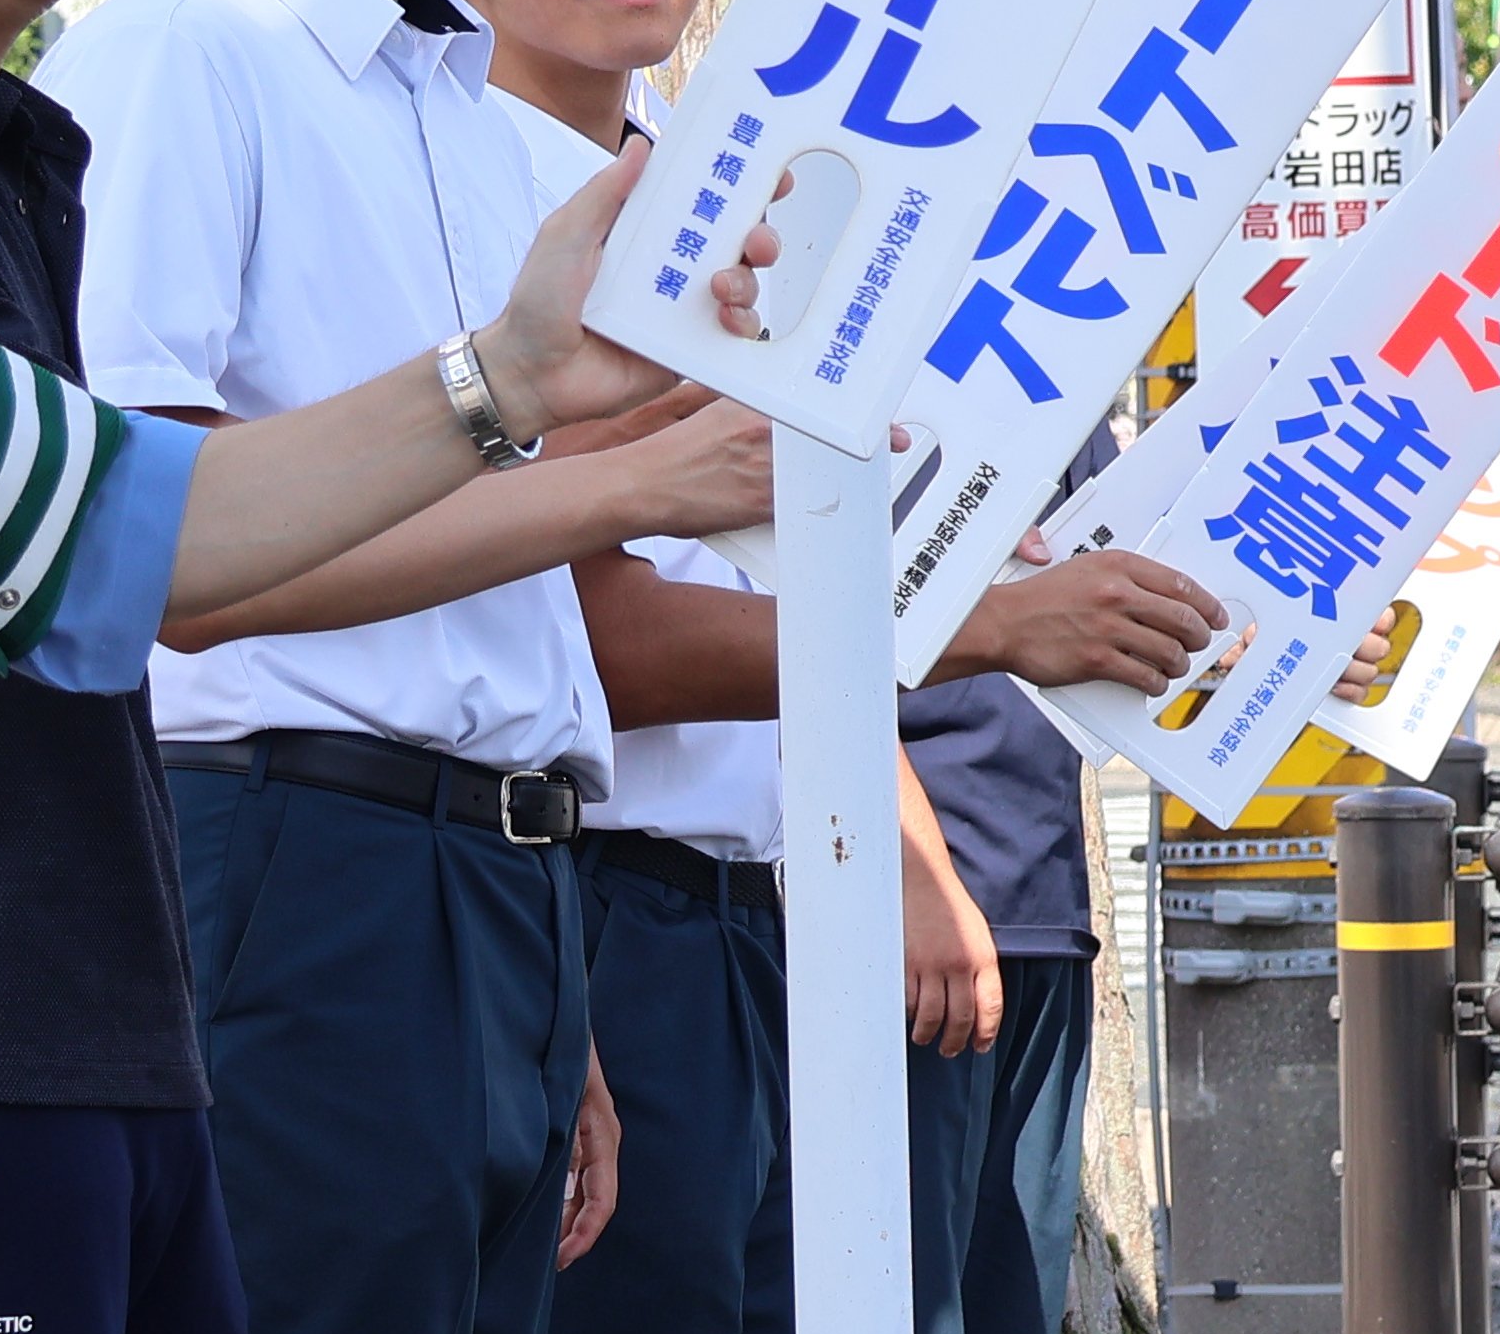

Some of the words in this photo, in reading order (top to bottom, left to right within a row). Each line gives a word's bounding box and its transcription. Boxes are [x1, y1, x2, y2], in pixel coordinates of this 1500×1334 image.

[656, 113, 765, 301] 豊橋警察署
[1242, 199, 1391, 242] 高価買
[1268, 148, 1402, 188] 岩田店
[816, 187, 932, 386] 交通安全協会豊橋支部
[1207, 638, 1310, 768] 豊橋交通安全協会
